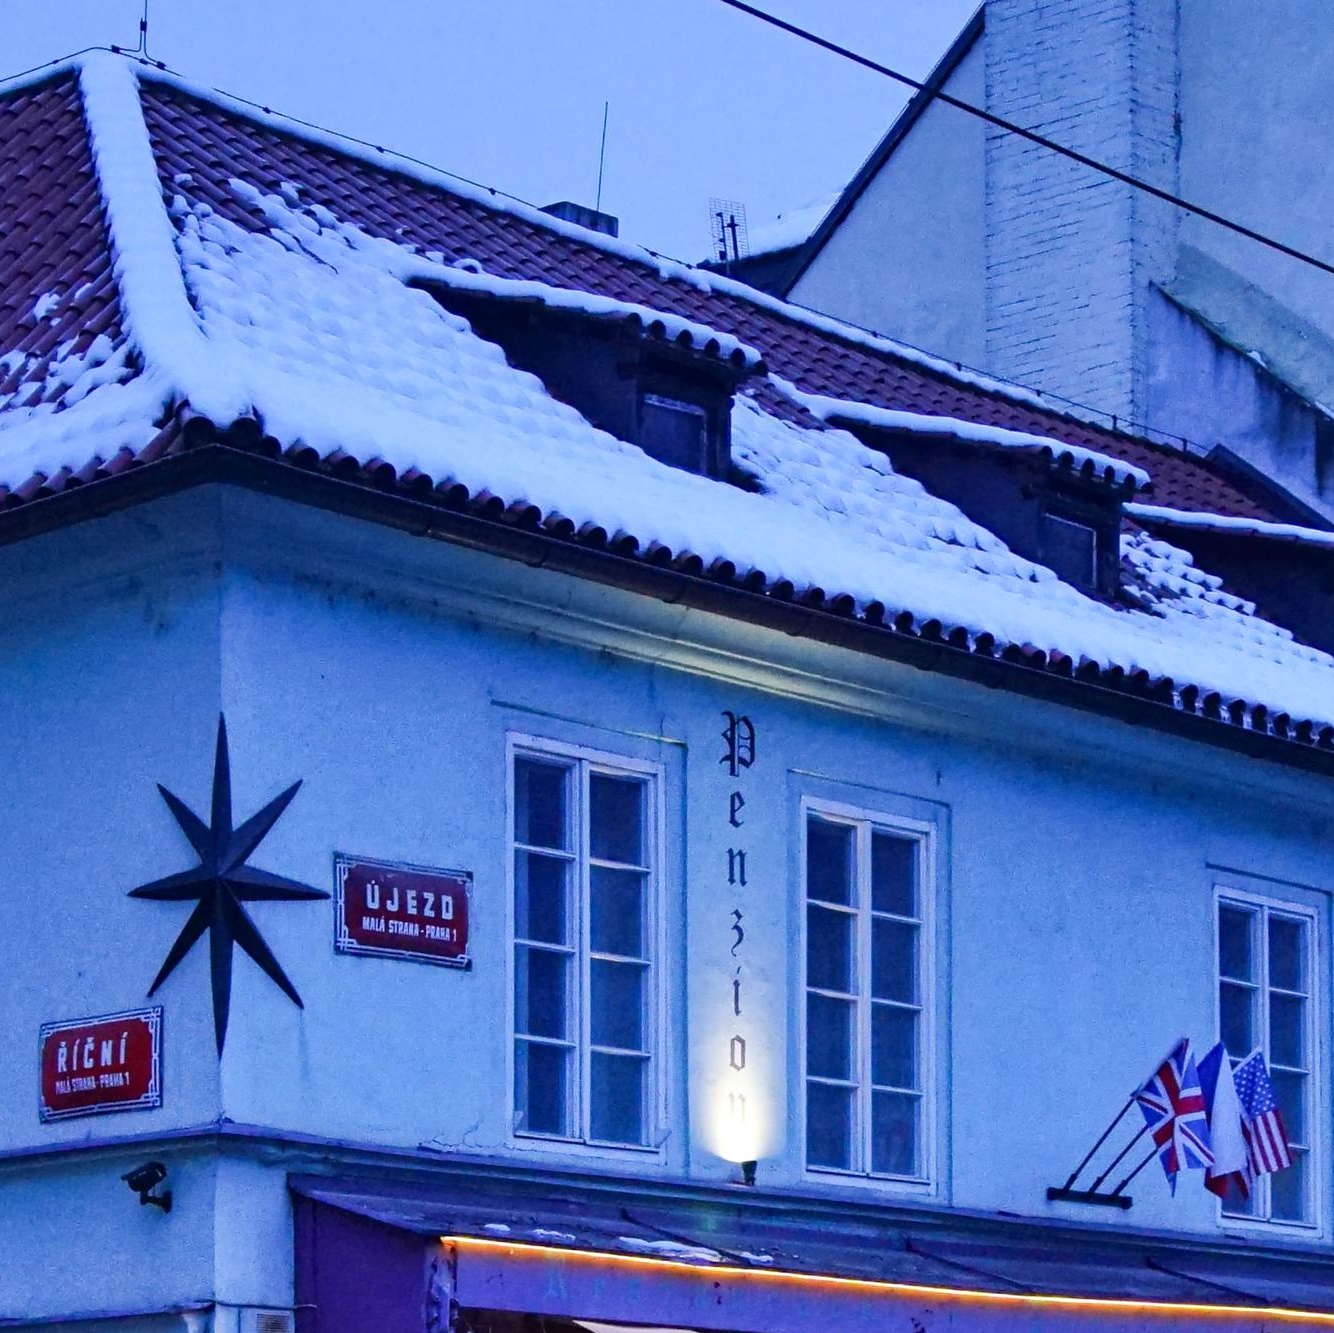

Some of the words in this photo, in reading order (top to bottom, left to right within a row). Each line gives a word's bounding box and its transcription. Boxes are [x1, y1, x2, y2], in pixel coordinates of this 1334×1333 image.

[366, 880, 454, 920] ÚJEZD
[362, 916, 385, 933] MALÁ
[388, 919, 419, 937] STRANA
[425, 925, 451, 941] PRAHA
[453, 928, 457, 942] 1
[57, 1031, 129, 1073] ŘÍČNÍ
